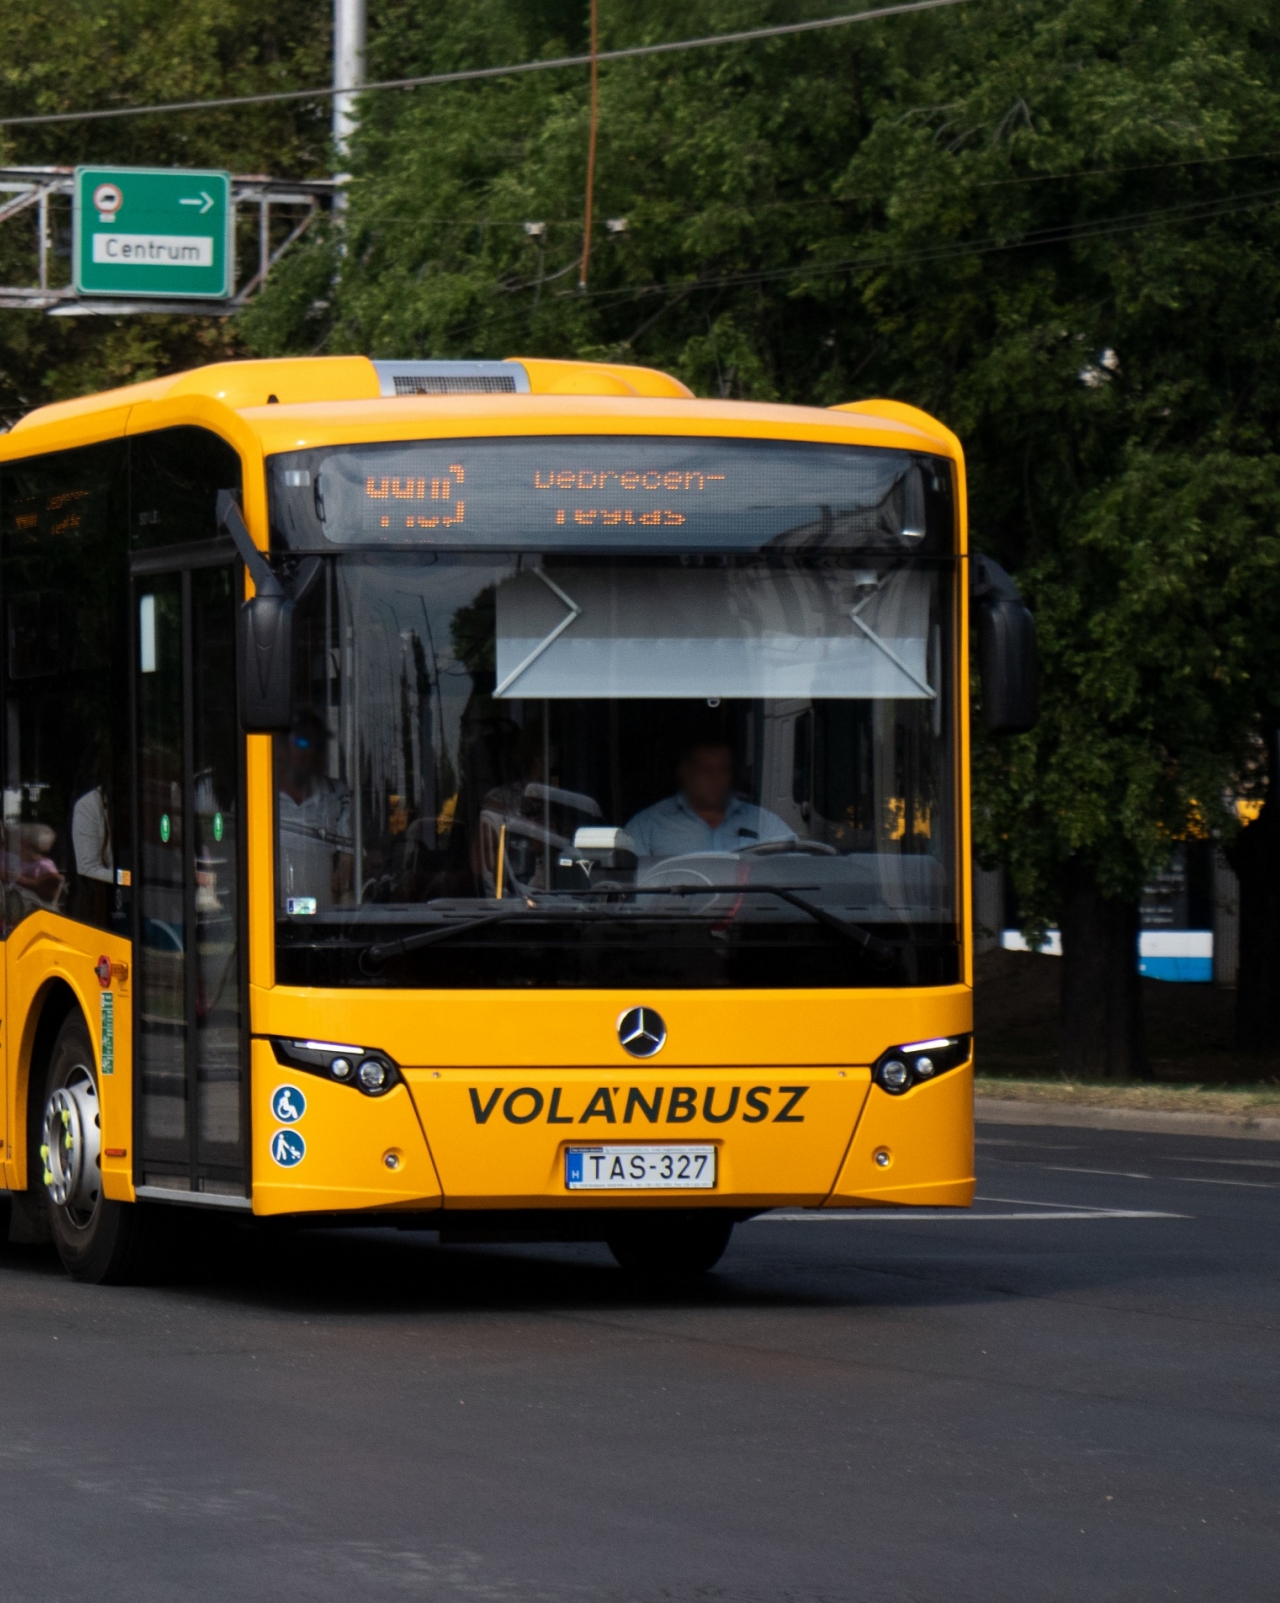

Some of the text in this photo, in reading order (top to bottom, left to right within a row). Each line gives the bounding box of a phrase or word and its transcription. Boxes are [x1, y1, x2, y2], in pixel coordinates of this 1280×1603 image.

[106, 237, 201, 261] Centrum
[468, 1086, 811, 1125] VOLÁNBUSZ
[589, 1155, 708, 1181] TAS-327
